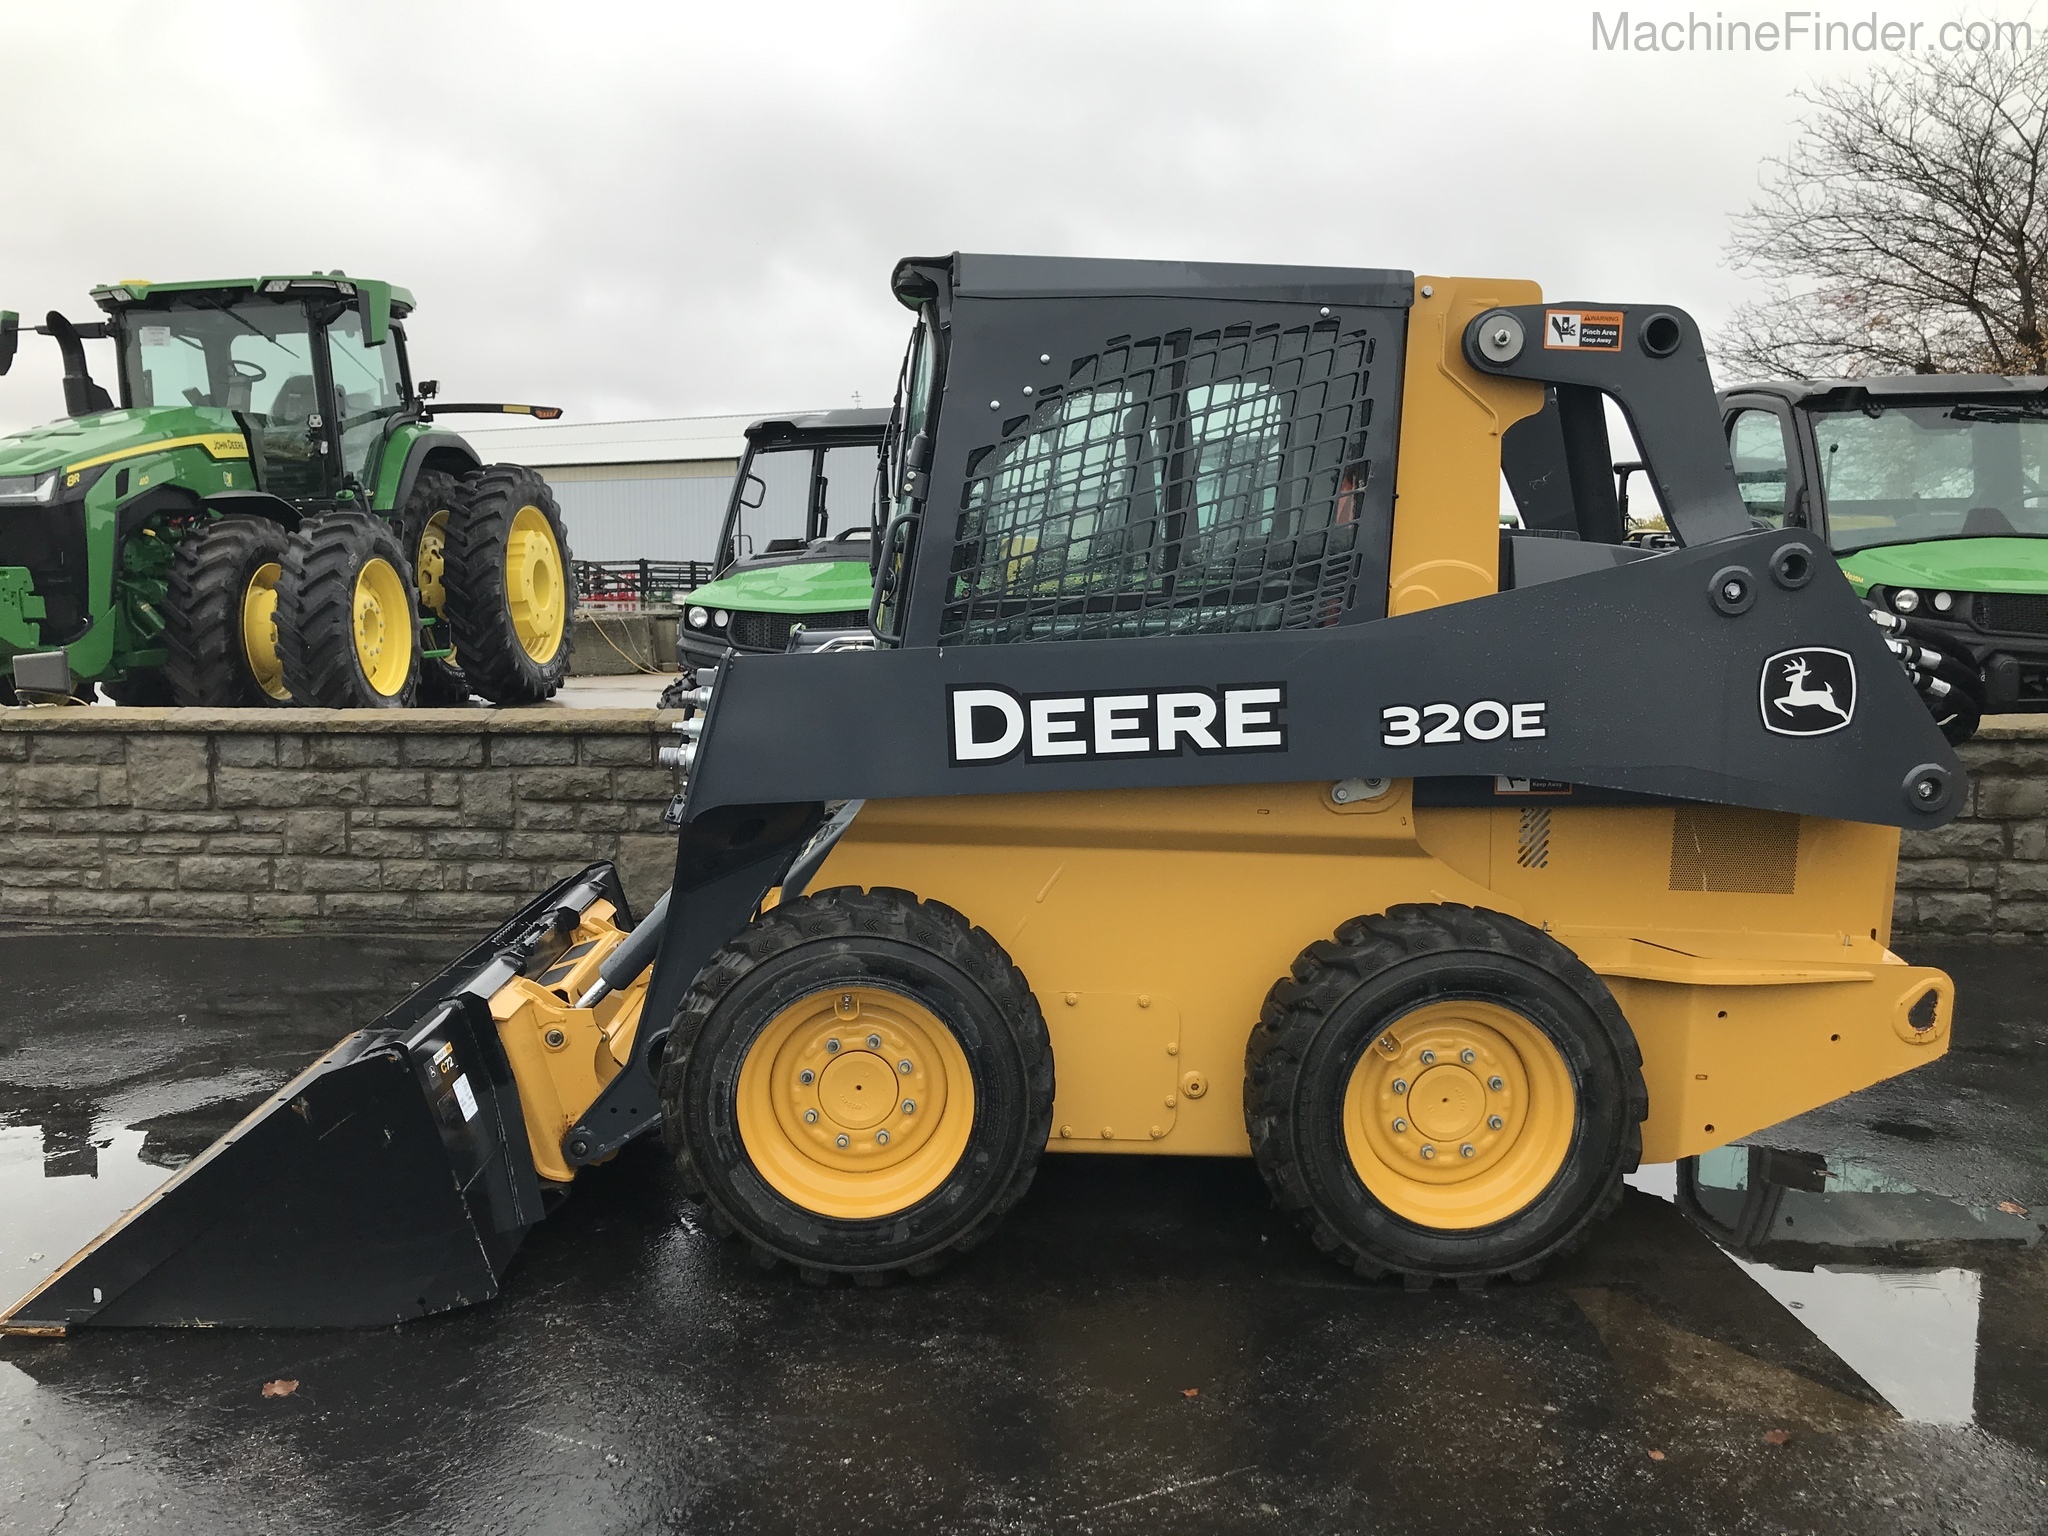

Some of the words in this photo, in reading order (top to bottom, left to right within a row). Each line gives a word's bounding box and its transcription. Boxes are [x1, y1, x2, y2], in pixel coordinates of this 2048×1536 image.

[1582, 328, 1600, 336] Pinch
[1582, 336, 1596, 344] Keep
[213, 440, 228, 450] JOHN
[227, 439, 245, 449] DEERE
[66, 472, 80, 488] 8R
[953, 688, 1282, 761] DEERE
[1383, 700, 1545, 746] 320E
[440, 1056, 454, 1073] C72
